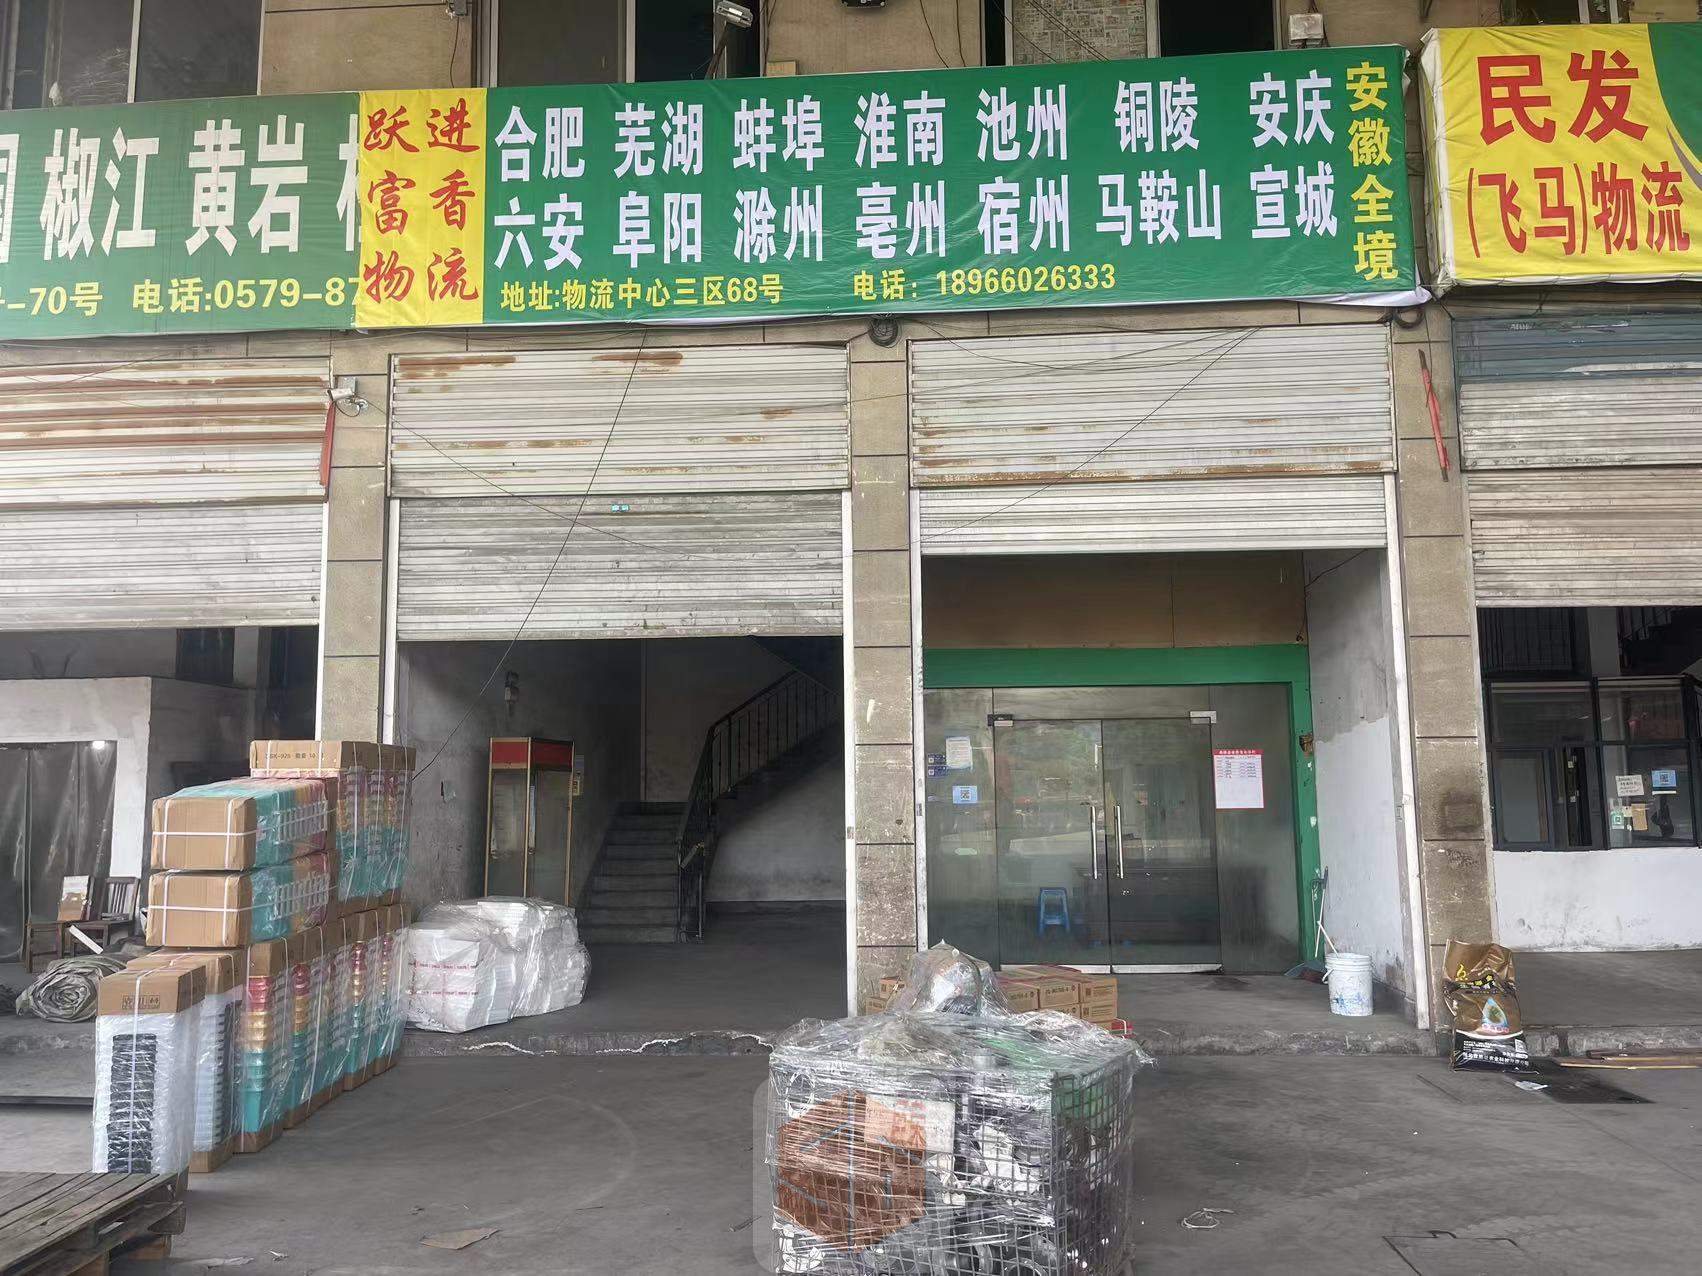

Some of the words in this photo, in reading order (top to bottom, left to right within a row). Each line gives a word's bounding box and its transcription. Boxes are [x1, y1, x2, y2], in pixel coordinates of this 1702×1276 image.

[364, 98, 482, 154] 跃进
[494, 105, 586, 183] 合肥
[613, 100, 704, 179] 芜湖
[732, 94, 826, 173] 蚌埠
[853, 90, 946, 169] 淮南
[976, 84, 1068, 162] 池州
[1113, 76, 1200, 153] 铜陵
[1249, 69, 1335, 148] 安庆
[1476, 49, 1649, 145] 民发
[39, 126, 160, 261] 椒江
[185, 113, 310, 257] 黄岩
[366, 168, 477, 236] 富香
[493, 193, 584, 271] 六安
[612, 190, 703, 269] 阜阳
[733, 184, 824, 264] 滁州
[855, 179, 946, 259] 亳州
[976, 174, 1070, 256] 宿州
[1095, 168, 1223, 247] 马鞍山
[1249, 160, 1338, 239] 宣城
[1346, 61, 1399, 281] 安徽全境
[1466, 161, 1691, 259] (飞马)物流
[363, 247, 480, 305] 物流
[499, 274, 784, 313] 地址:物流中心三区68号
